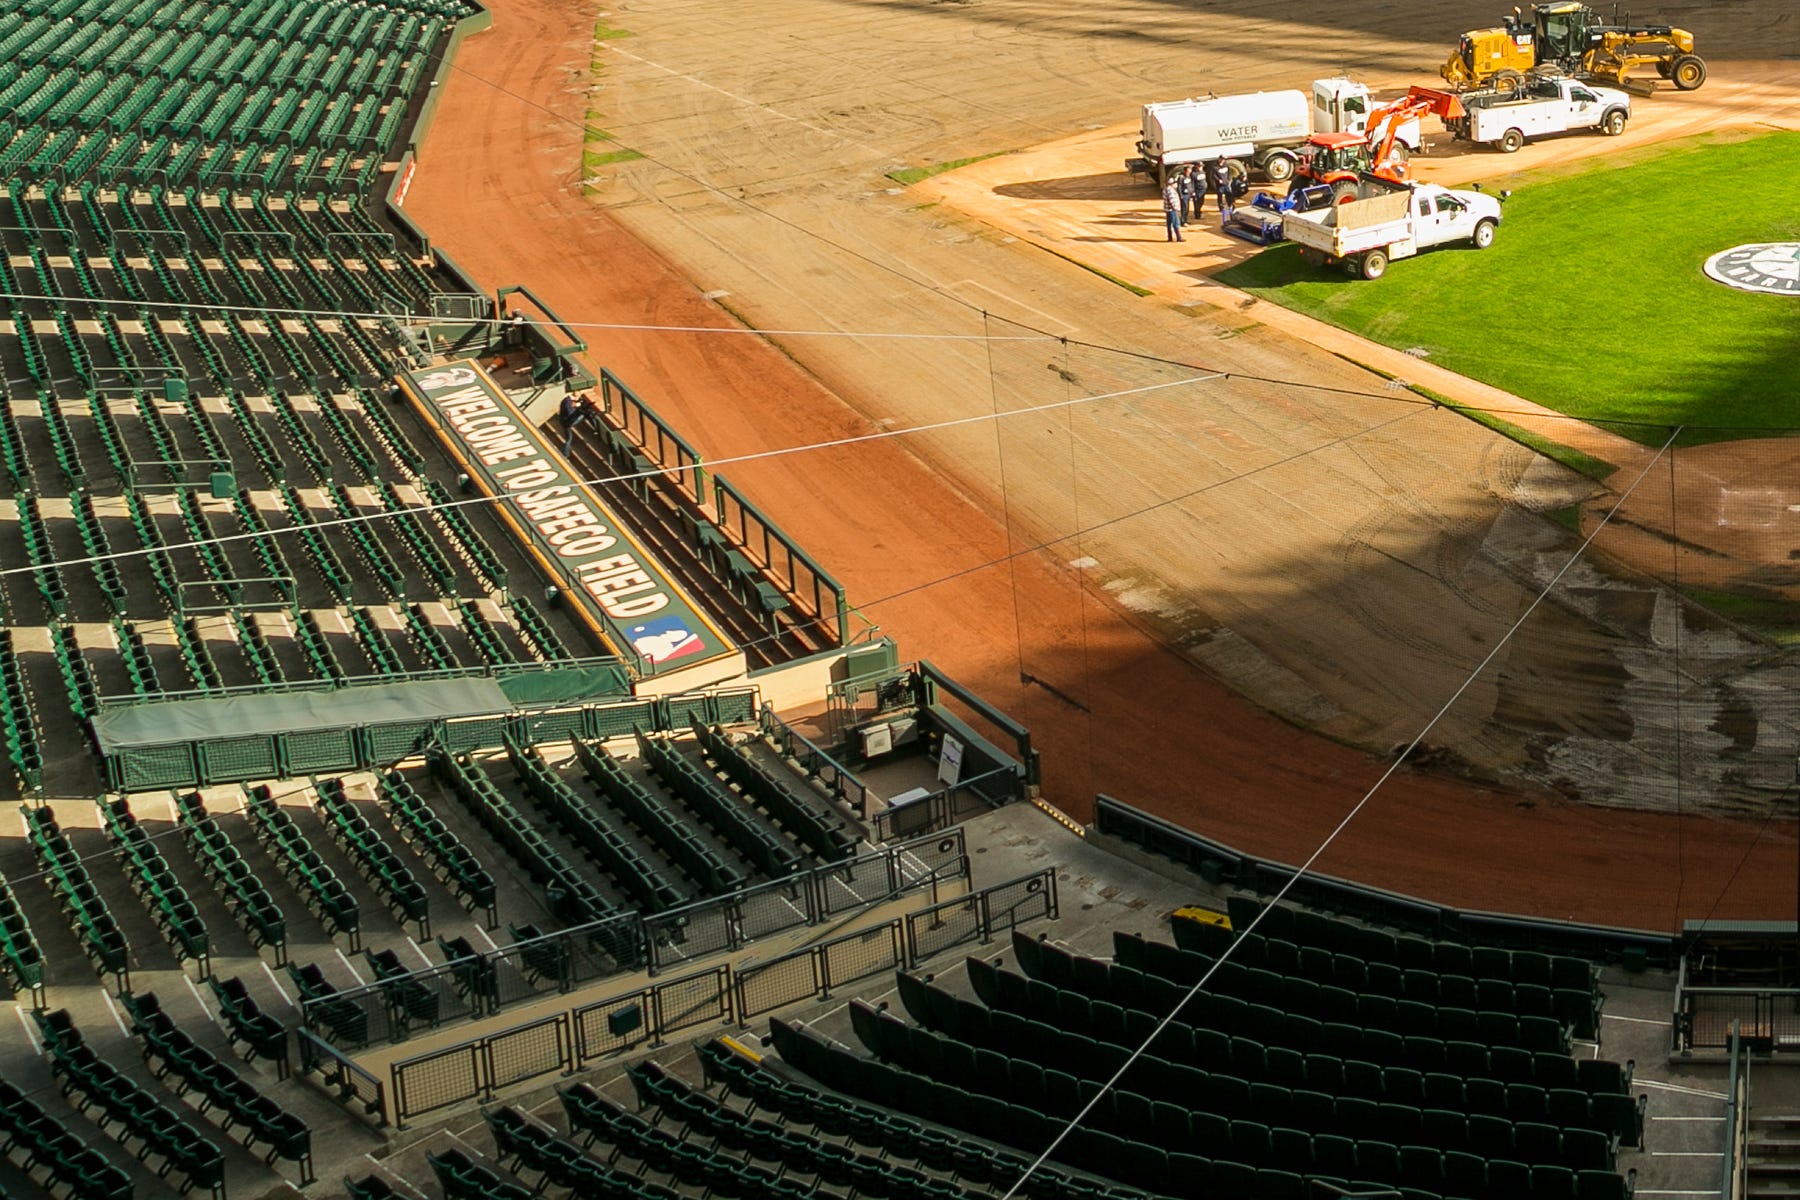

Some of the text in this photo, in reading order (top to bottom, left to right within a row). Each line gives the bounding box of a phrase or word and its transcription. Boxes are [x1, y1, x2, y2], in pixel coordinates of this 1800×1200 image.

[1517, 34, 1532, 45] CAT
[1218, 125, 1258, 137] WATER
[436, 385, 670, 618] WELCOME TO SAFECO FIELD
